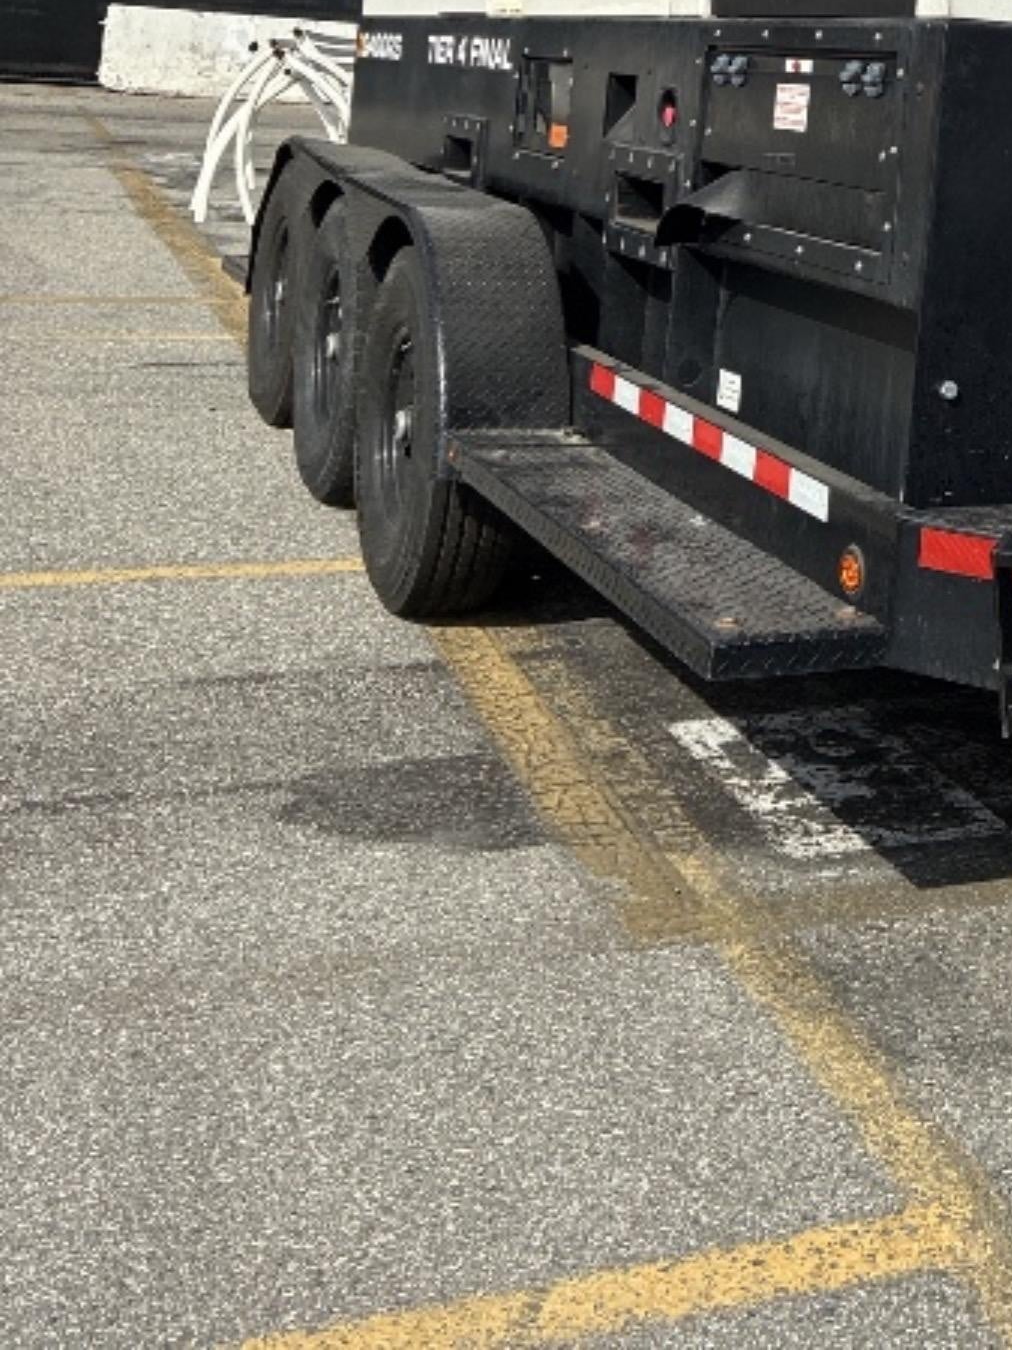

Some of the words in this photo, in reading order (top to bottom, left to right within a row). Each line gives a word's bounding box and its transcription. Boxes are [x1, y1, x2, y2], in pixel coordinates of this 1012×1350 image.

[428, 34, 455, 65] TIER
[458, 36, 469, 66] 4
[470, 36, 513, 71] FINAL
